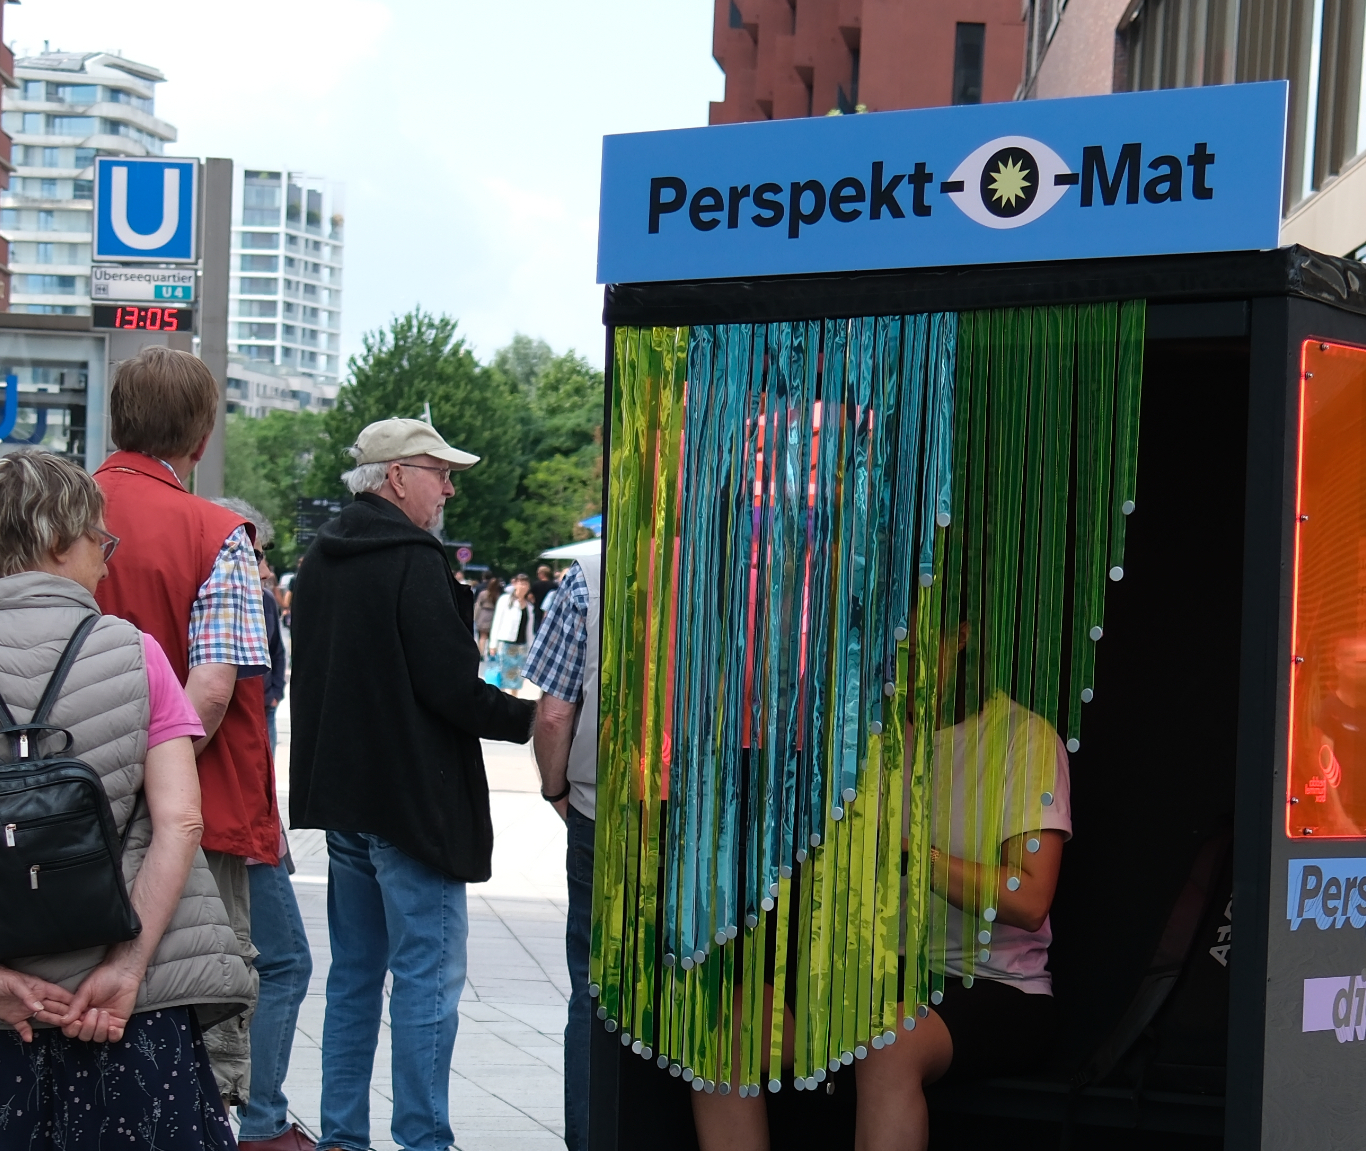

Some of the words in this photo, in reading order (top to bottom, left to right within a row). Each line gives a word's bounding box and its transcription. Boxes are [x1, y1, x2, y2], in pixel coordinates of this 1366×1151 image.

[111, 166, 180, 250] U
[94, 267, 193, 283] Überseequartier
[115, 307, 178, 331] 13:05
